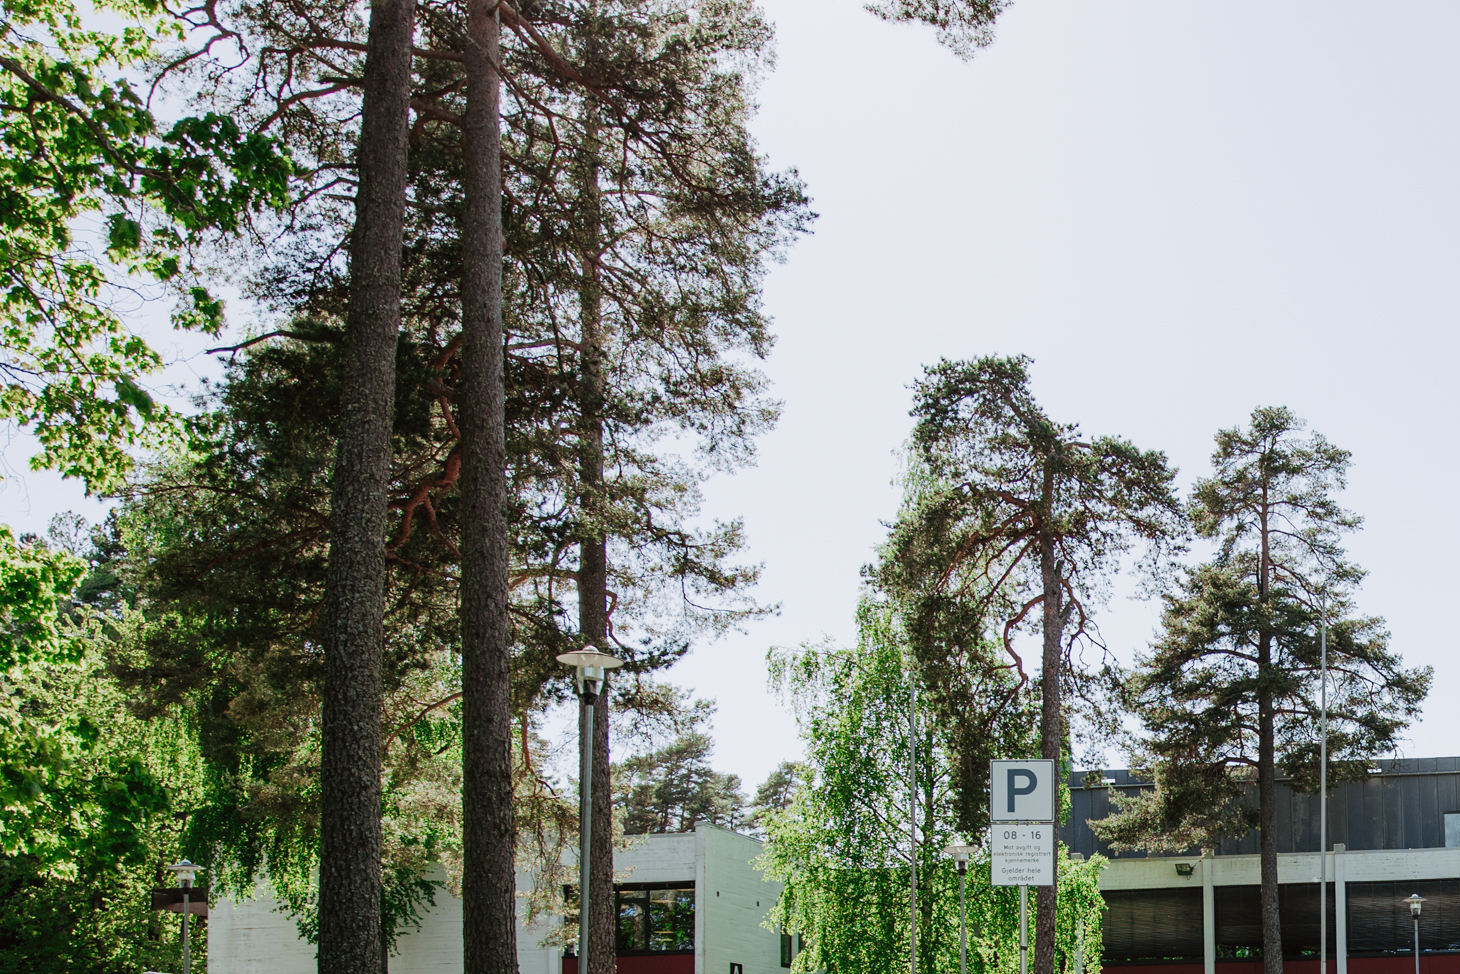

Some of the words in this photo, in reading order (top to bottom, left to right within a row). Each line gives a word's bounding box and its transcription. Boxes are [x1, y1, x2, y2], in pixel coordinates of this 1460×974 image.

[1007, 768, 1037, 812] P
[1003, 830, 1017, 840] 08
[1031, 830, 1041, 840] 16
[1002, 867, 1025, 875] Gjelder
